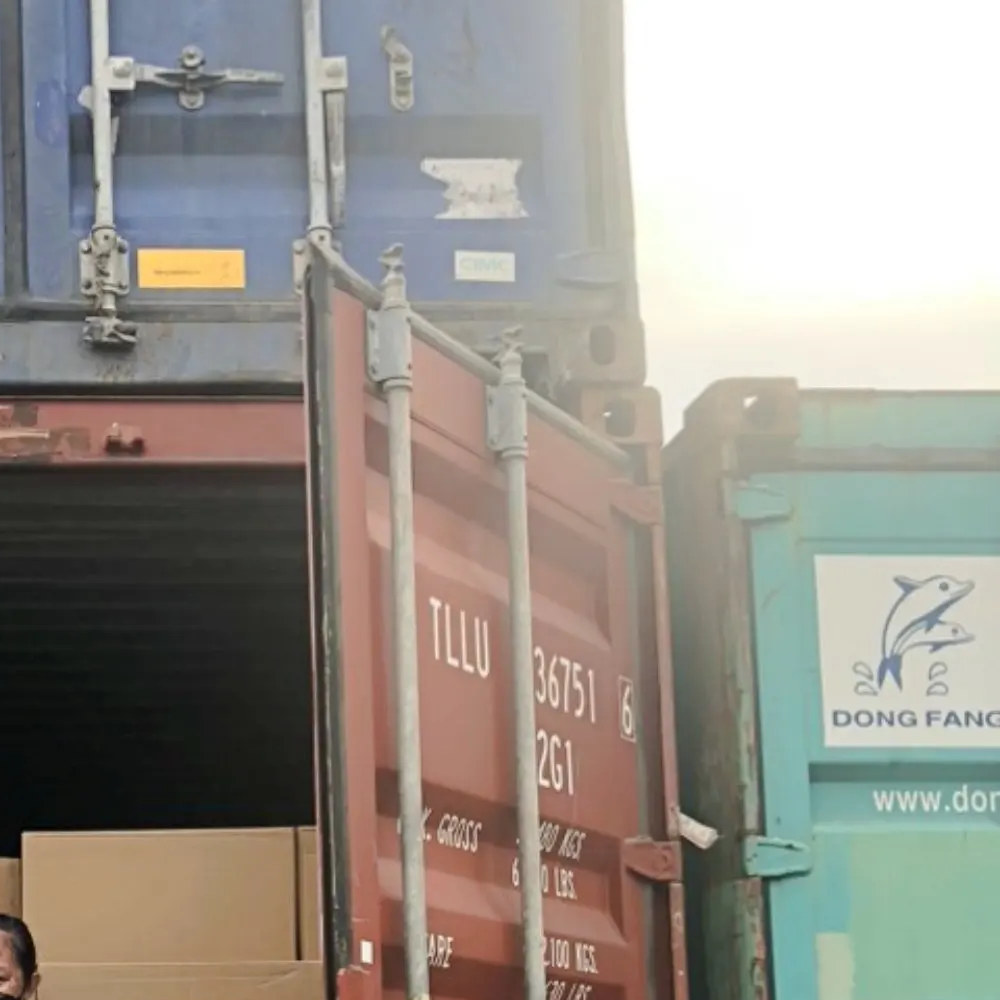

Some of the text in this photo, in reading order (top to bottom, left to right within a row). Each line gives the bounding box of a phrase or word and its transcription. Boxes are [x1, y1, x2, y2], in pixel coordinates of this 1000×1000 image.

[429, 597, 490, 679] TLLU
[534, 646, 633, 735] 36751 6
[832, 709, 1000, 728] DONG FANG
[536, 729, 574, 795] 2G1
[437, 813, 482, 853] GROSS
[428, 933, 454, 968] ARE
